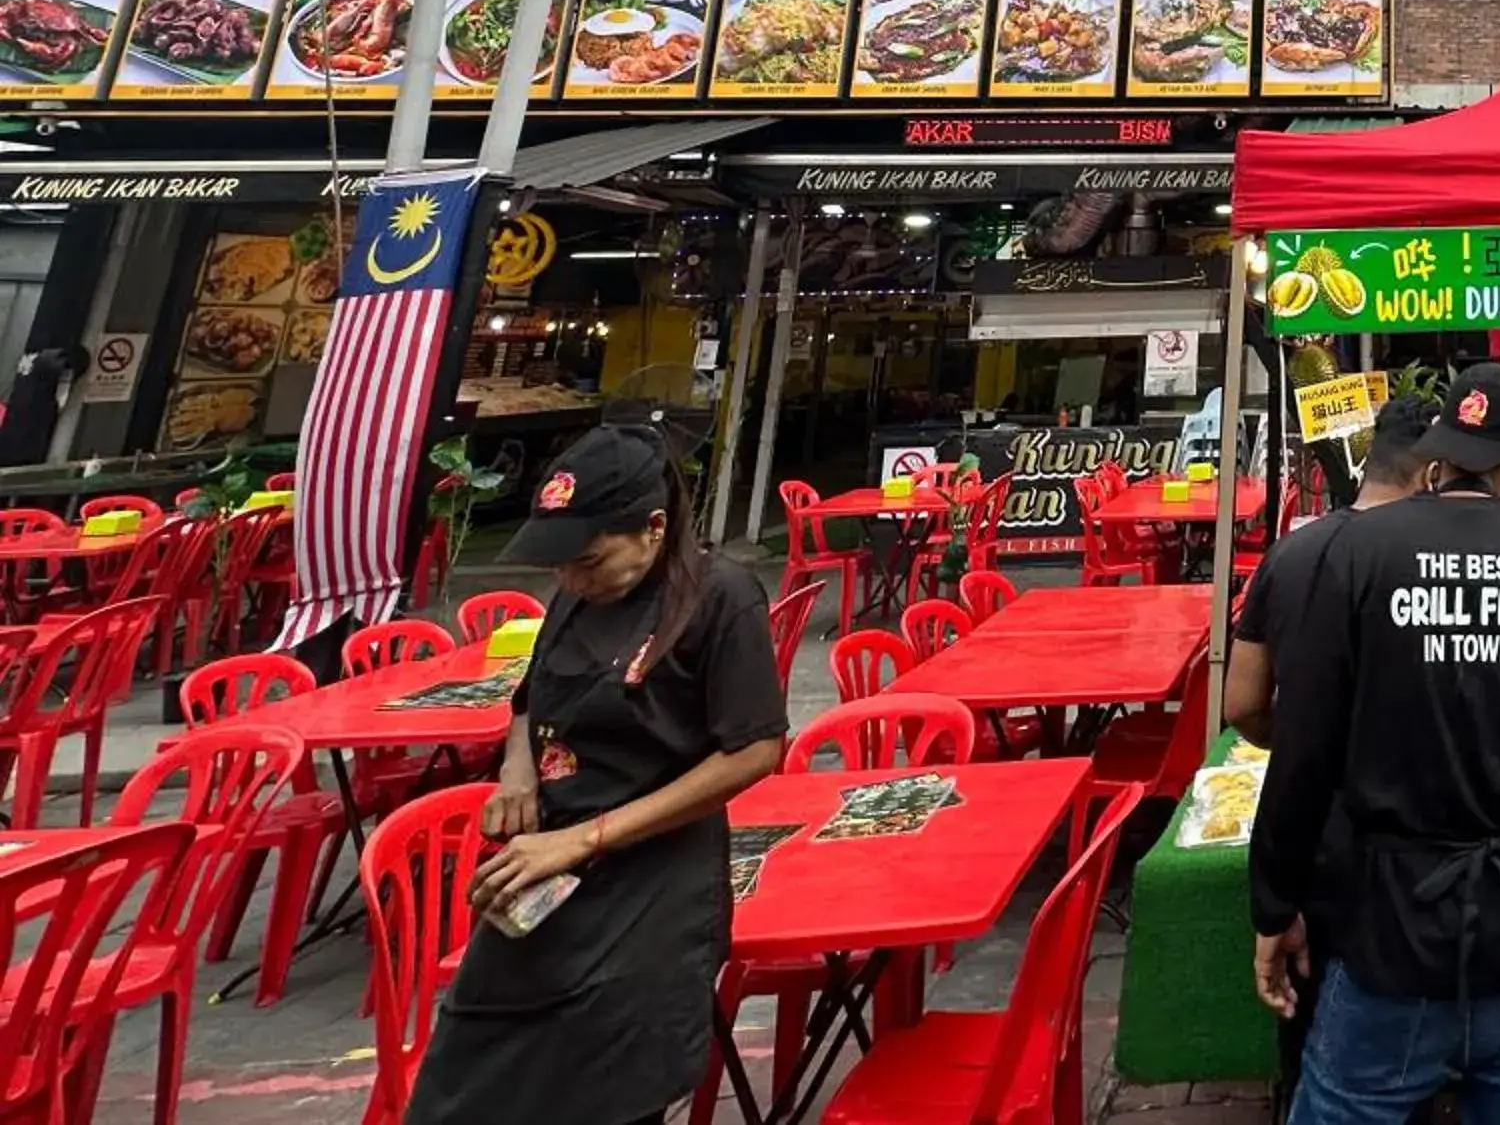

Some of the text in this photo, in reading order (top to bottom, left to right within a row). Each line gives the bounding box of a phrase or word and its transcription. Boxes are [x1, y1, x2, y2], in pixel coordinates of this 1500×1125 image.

[12, 175, 241, 200] KUNING IKAN BAKAR
[797, 168, 998, 191] KUNING IKAN BAKAR
[1075, 167, 1151, 189] KUNING
[1153, 169, 1202, 189] IKAN
[1375, 287, 1453, 322] WOW!
[1300, 385, 1339, 402] MUSANG
[1341, 378, 1364, 390] KING
[1007, 428, 1180, 478] Kuning
[1029, 538, 1076, 552] FISH
[1416, 552, 1461, 579] THE
[1390, 586, 1472, 628] GRILL
[1423, 634, 1445, 663] IN
